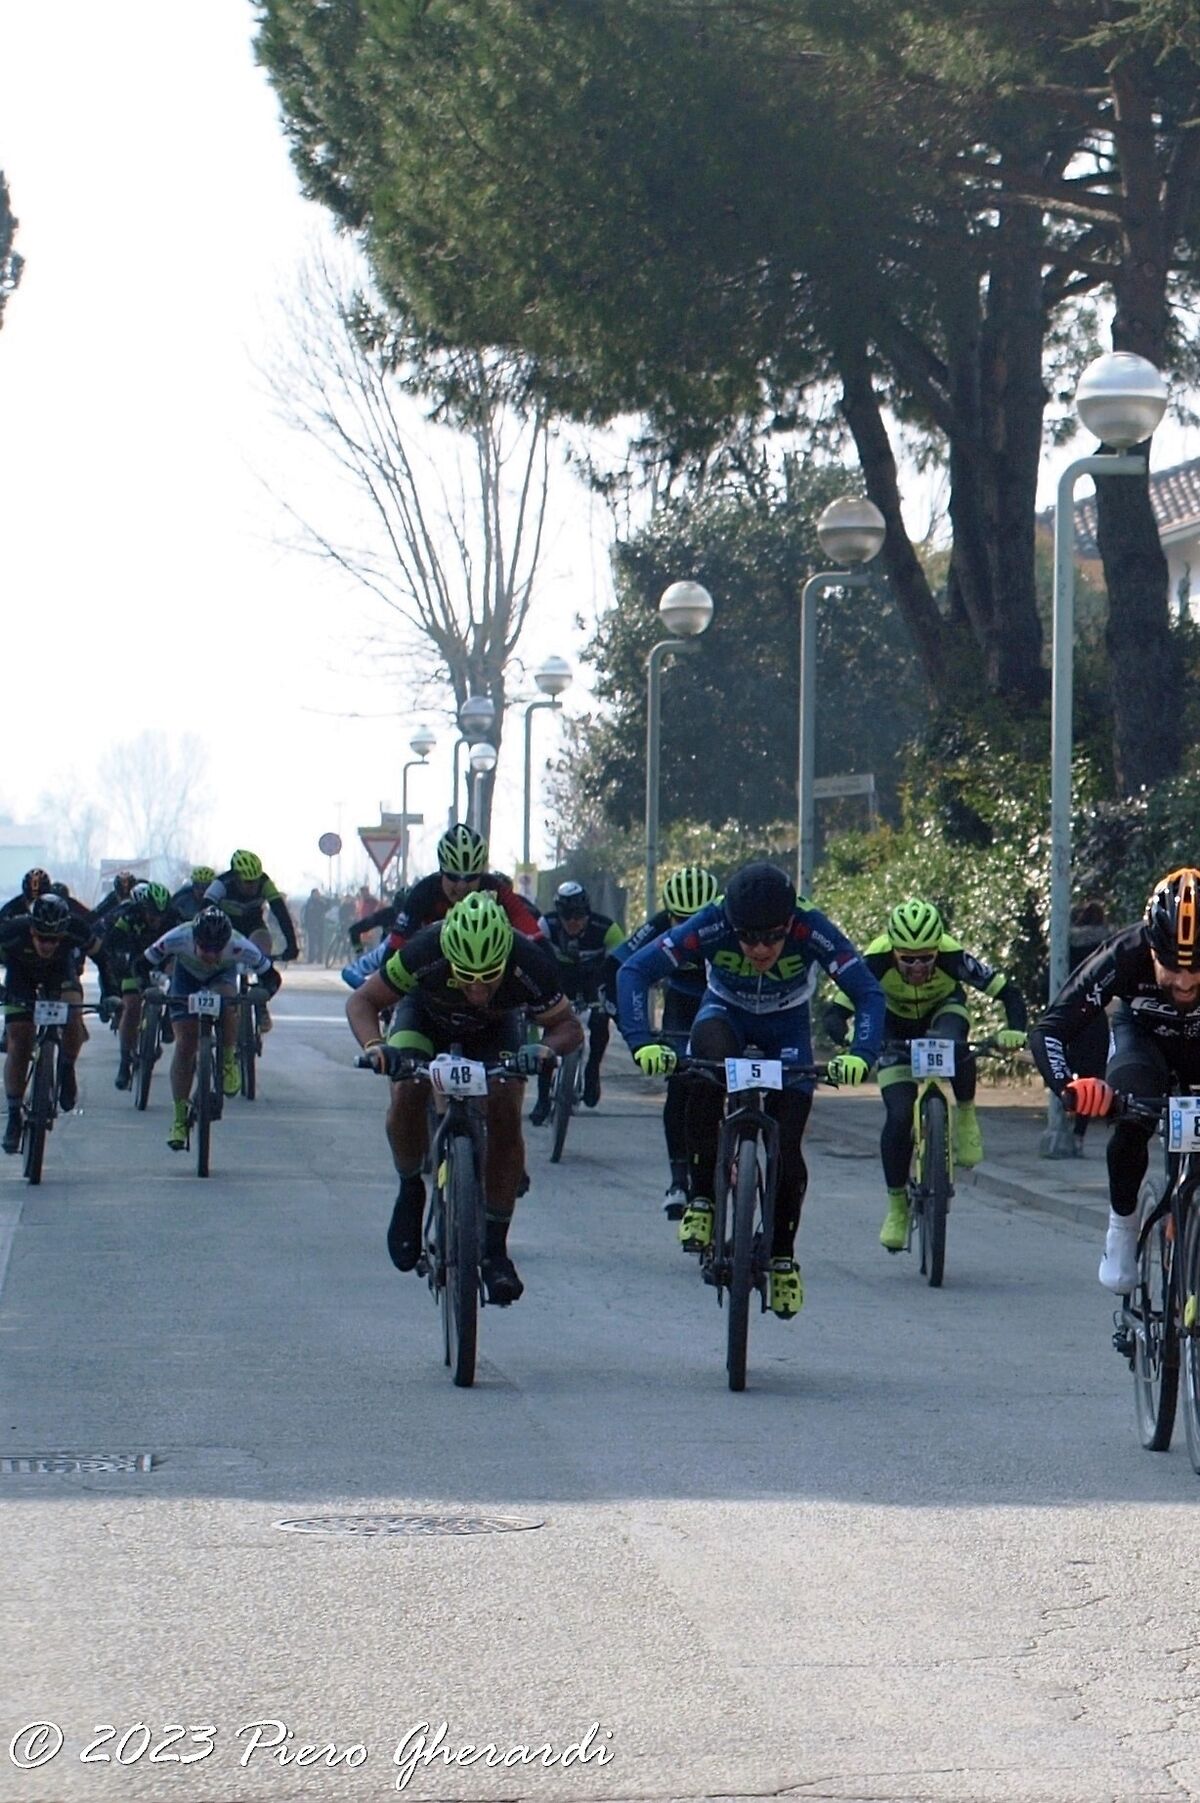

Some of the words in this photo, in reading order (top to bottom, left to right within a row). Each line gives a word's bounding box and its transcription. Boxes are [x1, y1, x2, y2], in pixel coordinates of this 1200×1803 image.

[927, 1053, 944, 1067] 96
[450, 1065, 473, 1085] 48
[751, 1063, 761, 1079] 5
